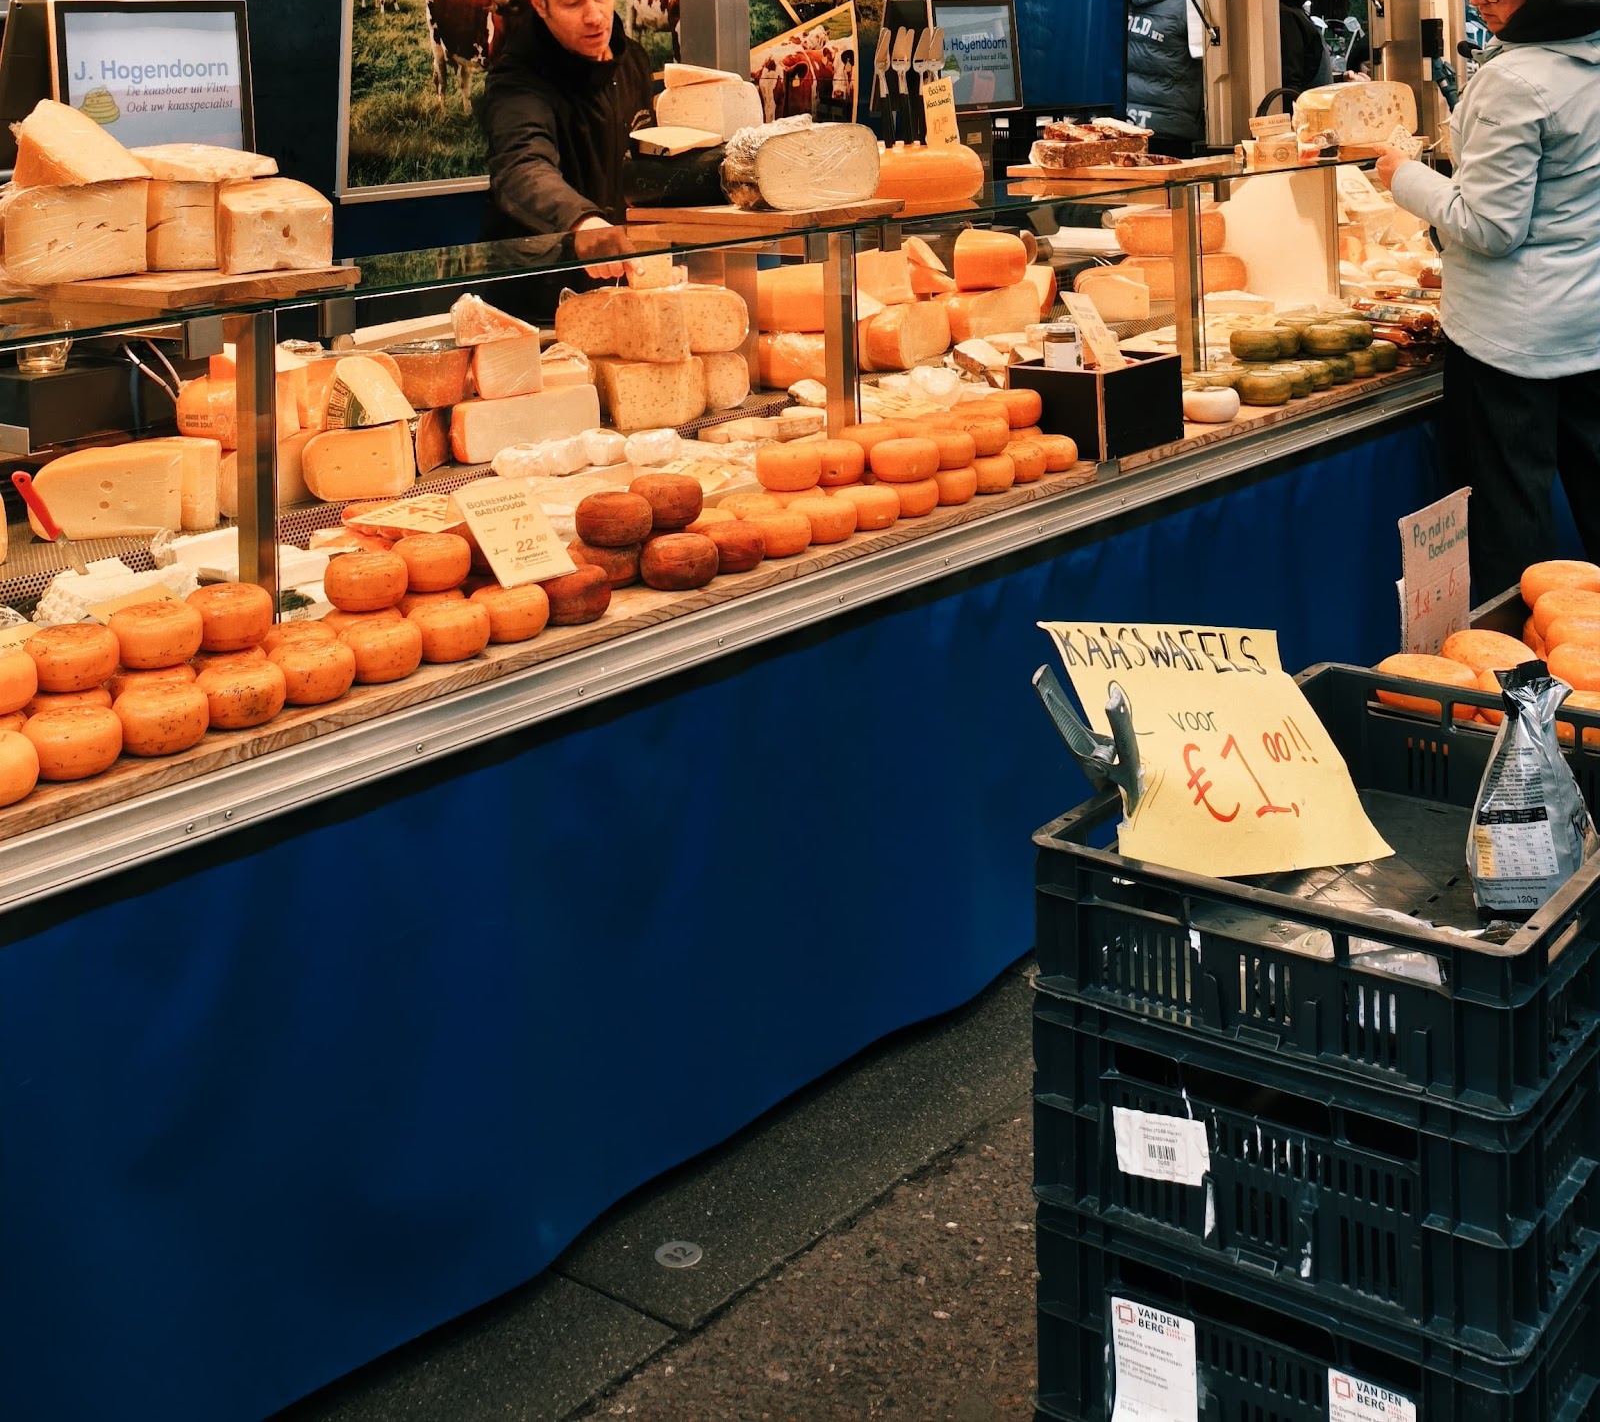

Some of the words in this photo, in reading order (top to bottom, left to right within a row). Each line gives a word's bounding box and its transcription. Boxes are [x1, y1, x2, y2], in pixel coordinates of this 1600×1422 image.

[951, 37, 1008, 53] Hogendoorn
[74, 61, 93, 81] J.
[101, 58, 229, 84] Hogendoorn
[126, 85, 140, 96] De
[143, 84, 188, 96] kaasboer
[190, 83, 203, 94] uit
[126, 101, 148, 113] Ook
[150, 104, 164, 112] uw
[167, 98, 233, 113] kaasspecialist
[466, 492, 526, 510] BOERENKAAS
[474, 500, 527, 517] BABYGOUDA
[1413, 510, 1456, 549] Pondjes
[1059, 627, 1267, 674] KAASWAFELS
[1517, 896, 1538, 905] 120g
[1138, 1307, 1158, 1320] VAN
[1160, 1314, 1180, 1329] DEN
[1138, 1318, 1164, 1334] BERG
[1356, 1381, 1378, 1397] VAN
[1381, 1389, 1402, 1407] DEN
[1357, 1393, 1385, 1411] BERG
